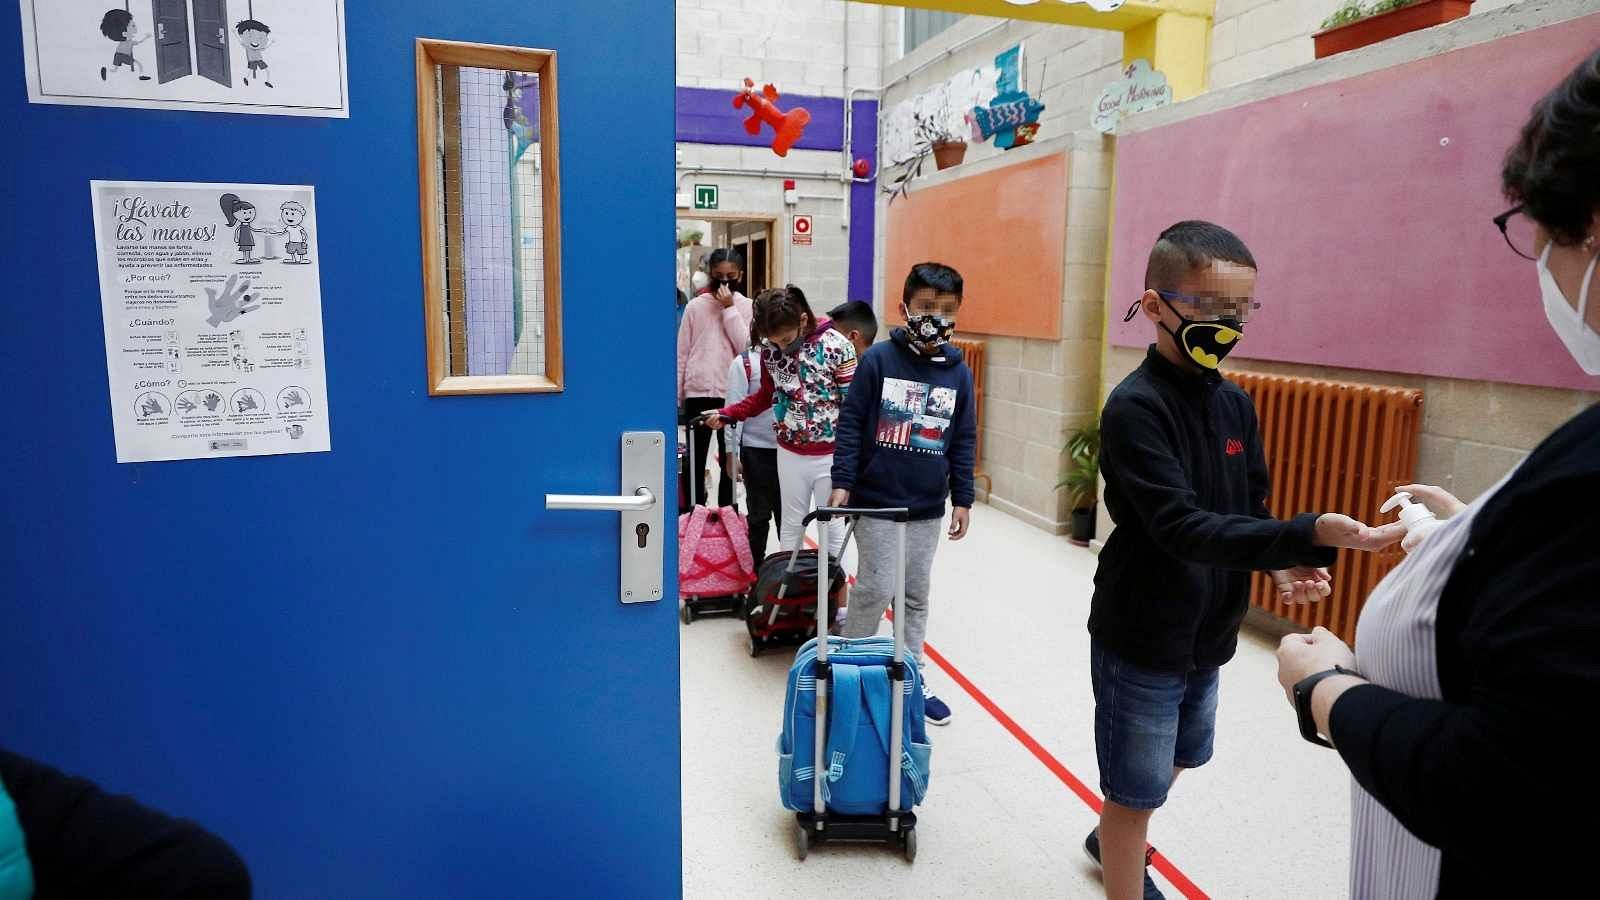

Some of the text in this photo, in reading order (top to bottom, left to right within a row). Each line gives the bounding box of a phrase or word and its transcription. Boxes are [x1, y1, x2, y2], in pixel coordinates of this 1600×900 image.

[113, 196, 193, 226] ¡Lávate
[116, 223, 217, 241] las manos!
[125, 273, 171, 284] ¿Por qué?
[129, 318, 175, 328] ¿Cuándo?
[134, 379, 171, 390] ¿Cómo?
